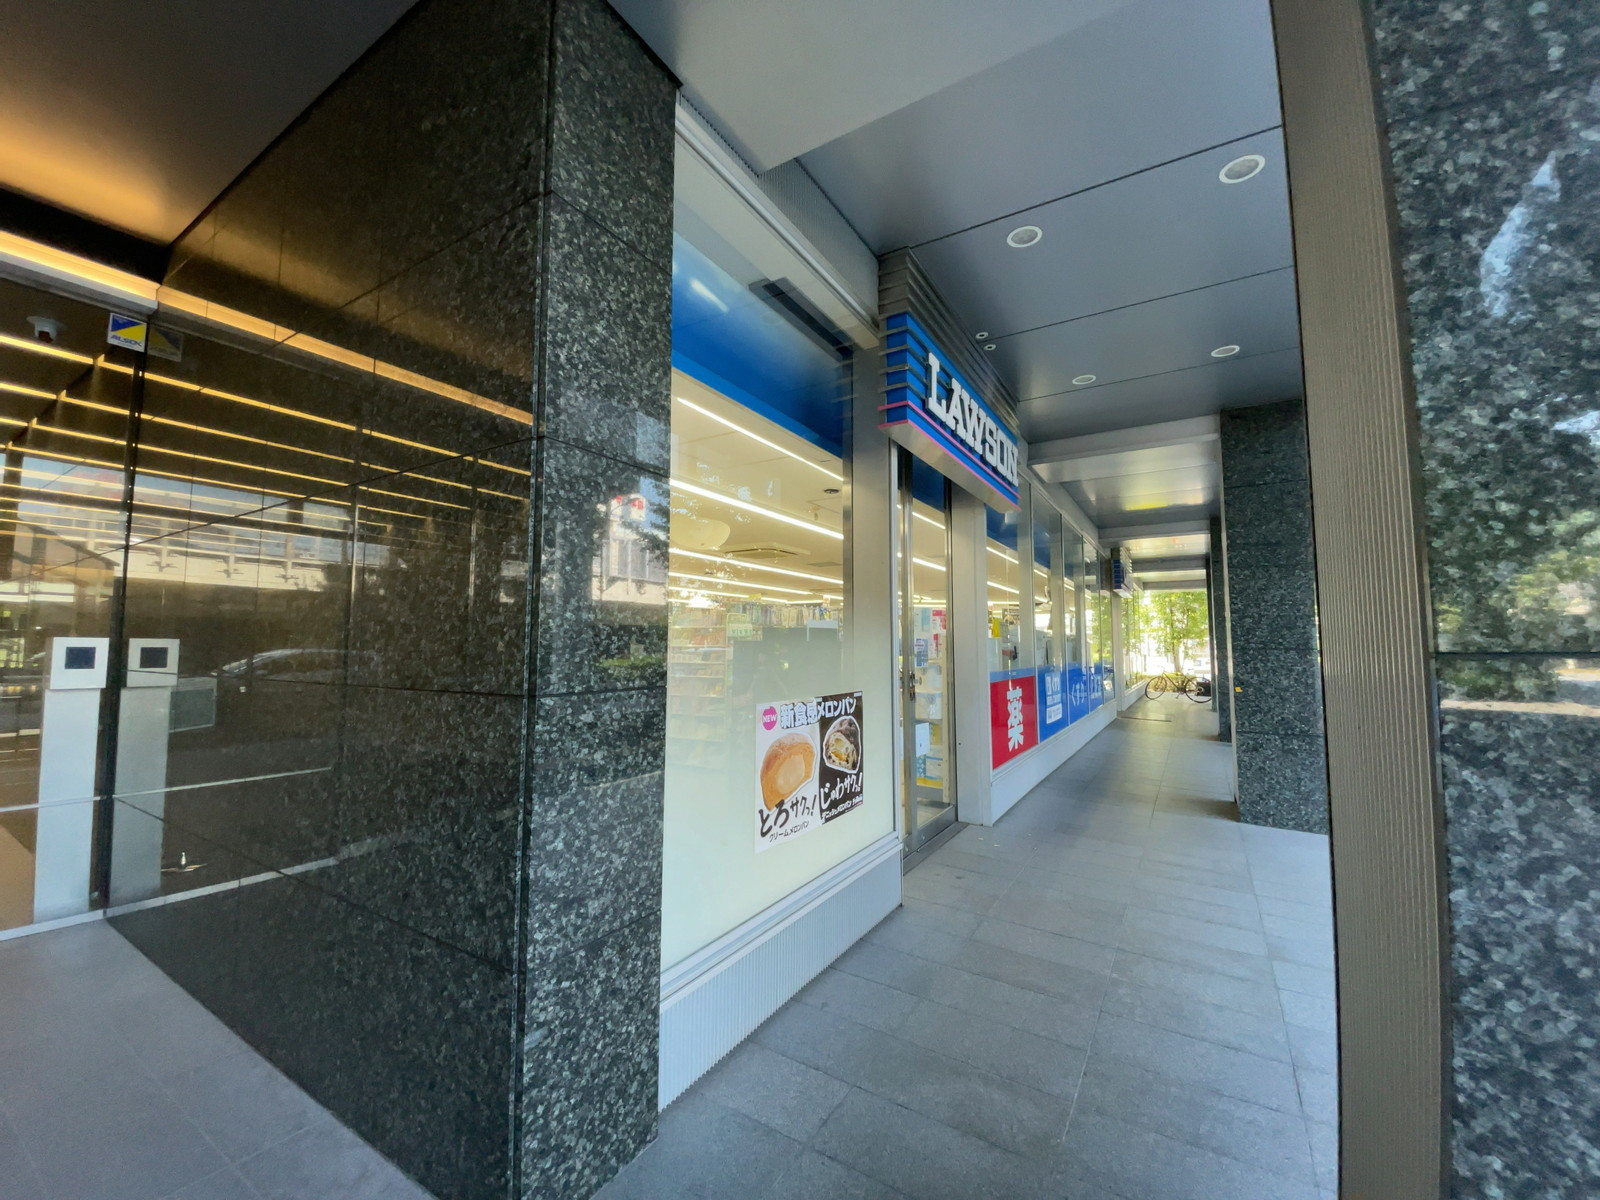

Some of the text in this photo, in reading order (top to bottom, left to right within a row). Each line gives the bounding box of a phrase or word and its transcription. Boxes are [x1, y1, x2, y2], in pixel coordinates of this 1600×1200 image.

[928, 352, 1018, 486] LAWSON
[763, 714, 777, 723] NEW
[780, 696, 857, 729] 新食感メロンパン
[1007, 686, 1024, 752] 募集
